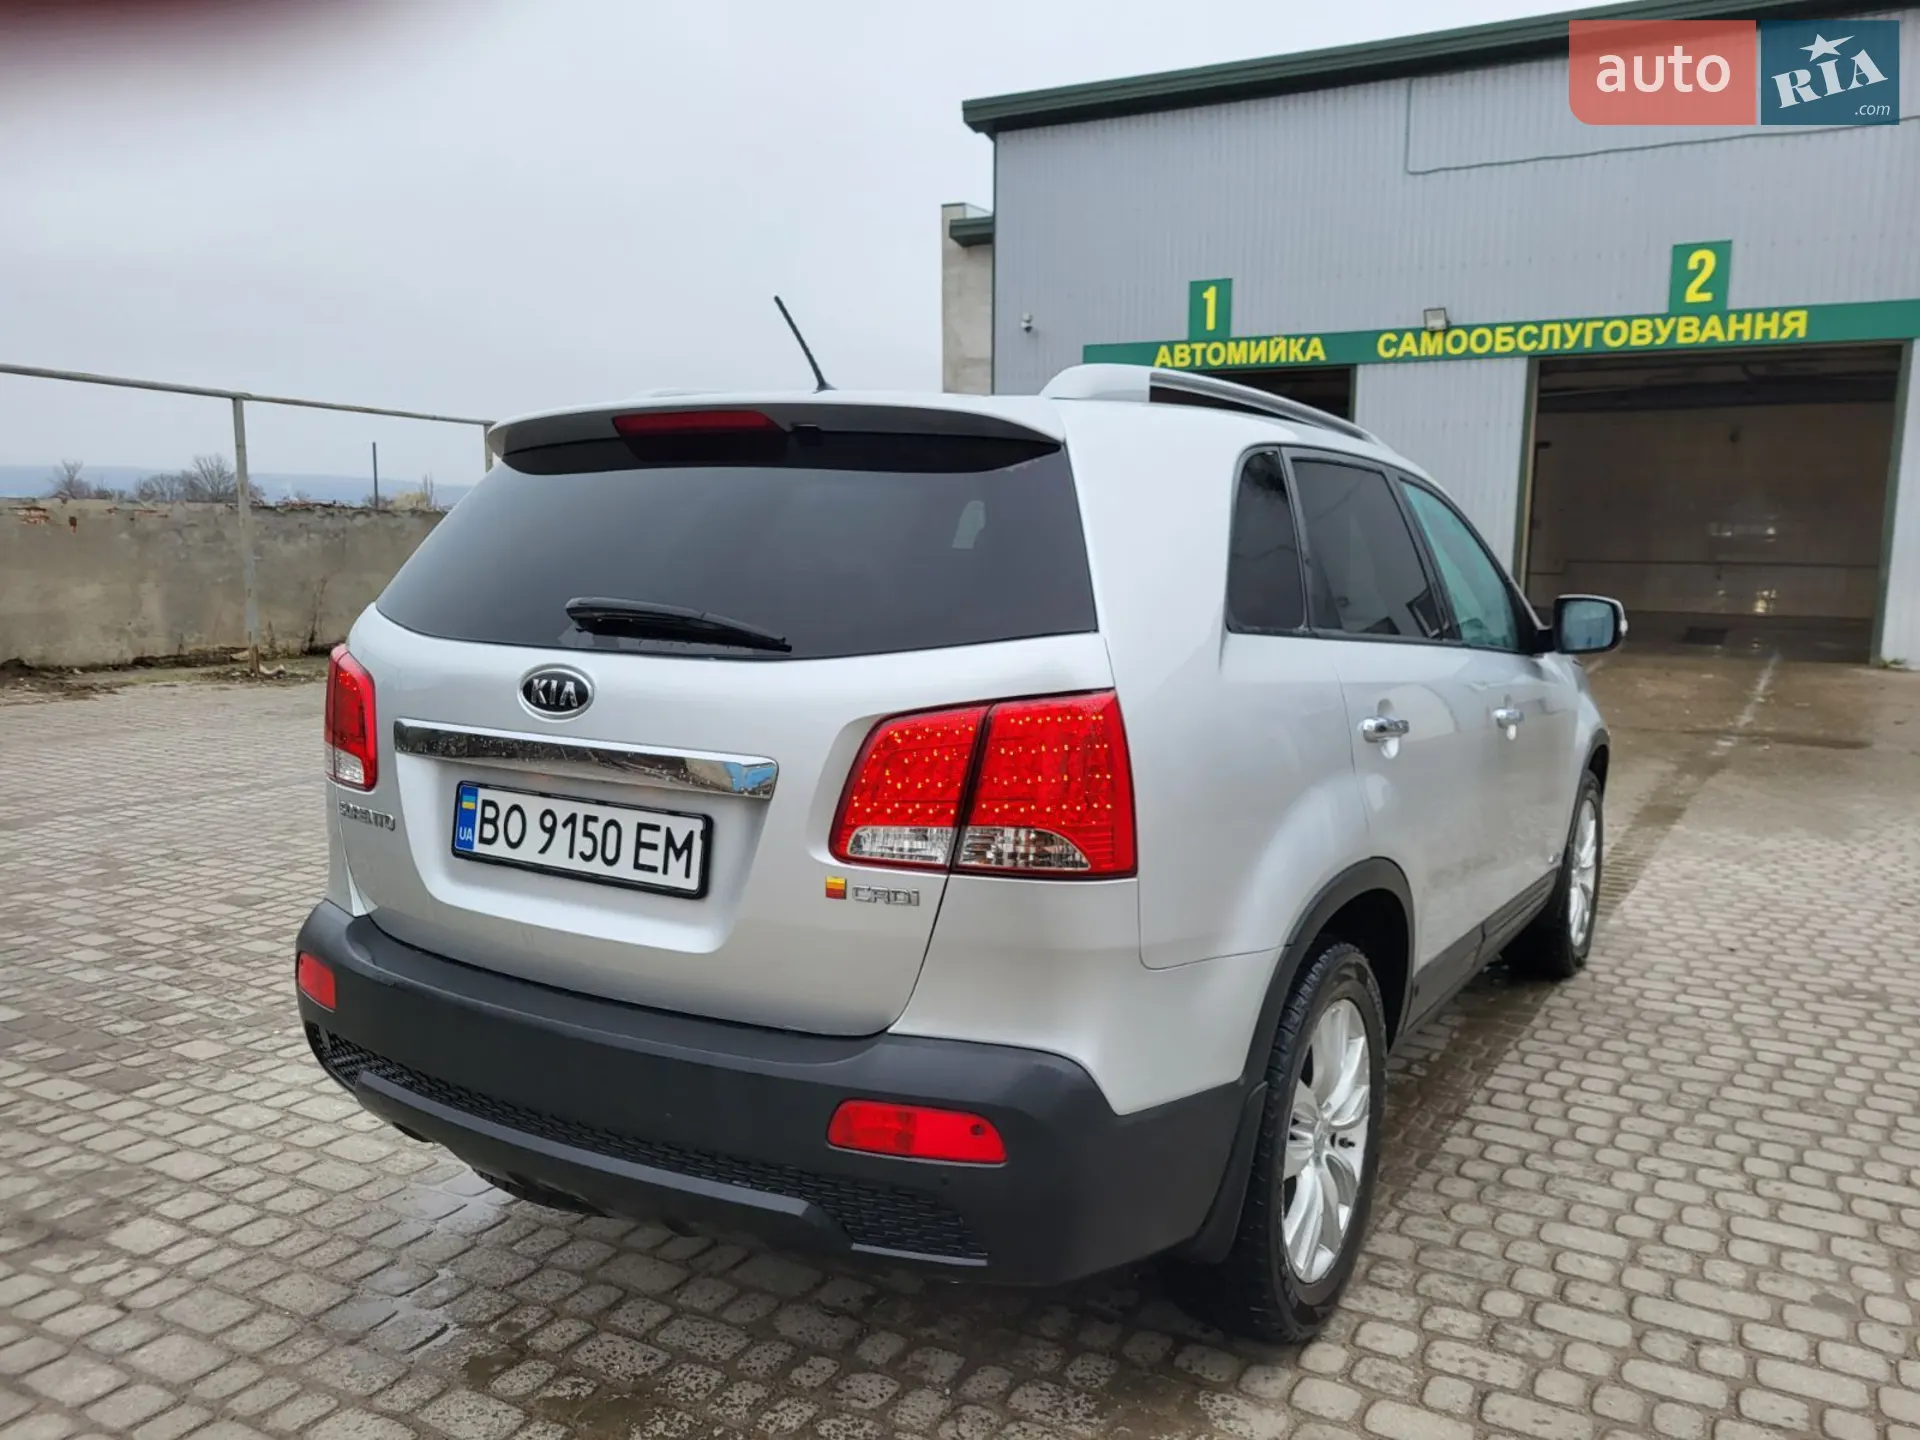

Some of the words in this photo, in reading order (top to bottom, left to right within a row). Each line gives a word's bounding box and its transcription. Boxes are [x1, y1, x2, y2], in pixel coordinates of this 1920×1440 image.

[1685, 248, 1717, 303] 2
[1201, 286, 1218, 331] 1
[1154, 336, 1326, 368] АВТОМИЙКА
[1376, 310, 1808, 358] САМООБСЛУГОВУВАННЯ
[531, 678, 580, 708] KIA
[458, 826, 474, 842] UA
[478, 799, 527, 849] BO
[538, 808, 622, 866] 9150
[633, 822, 694, 879] EM
